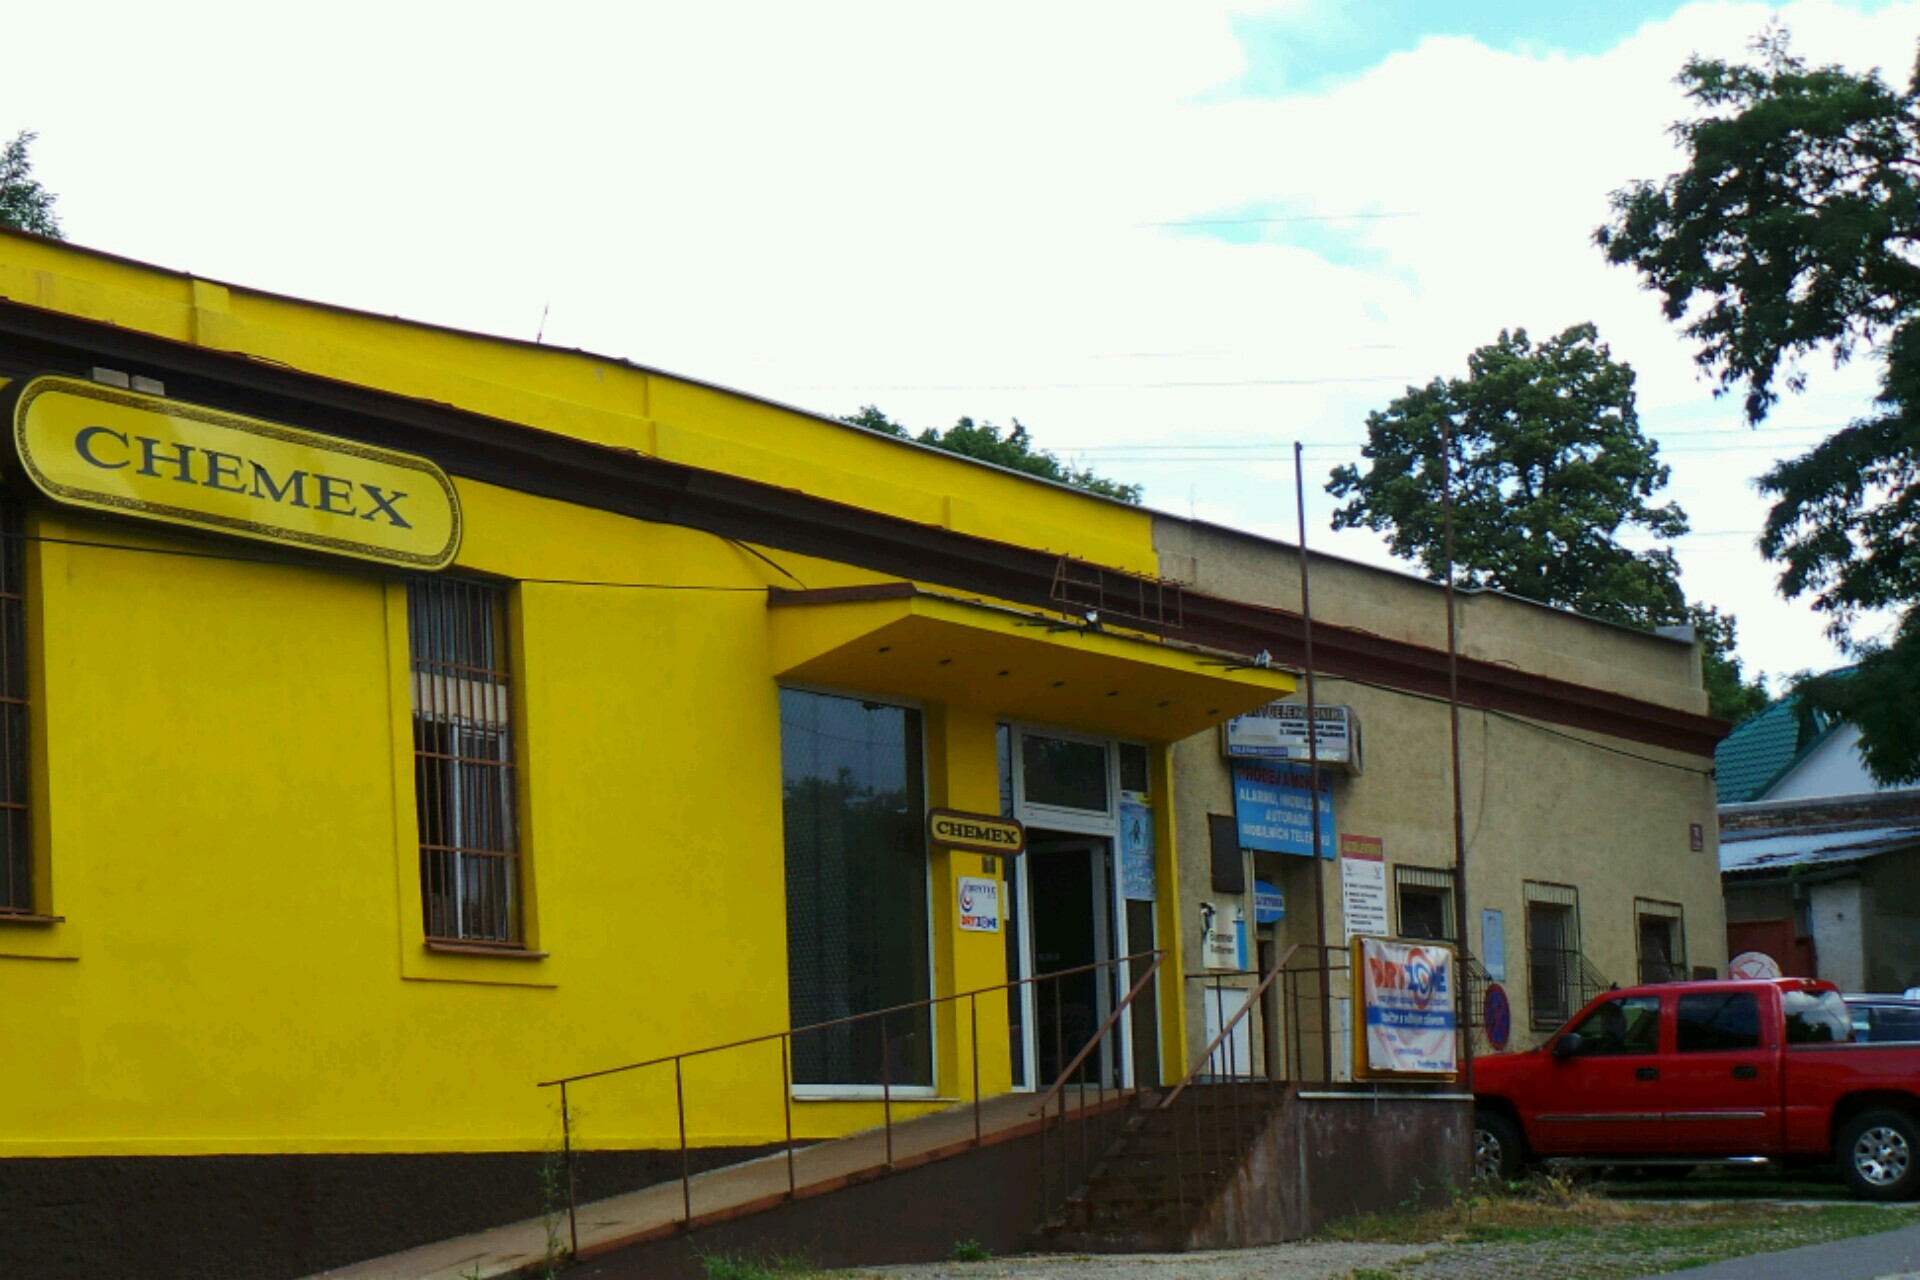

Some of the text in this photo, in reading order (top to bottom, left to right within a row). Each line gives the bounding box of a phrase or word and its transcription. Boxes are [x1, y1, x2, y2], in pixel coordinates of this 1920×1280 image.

[75, 425, 413, 530] CHEMEX
[935, 821, 1018, 844] CHEMEX
[1290, 829, 1331, 847] TELEFNŮ
[1370, 949, 1447, 1006] DRYZONE
